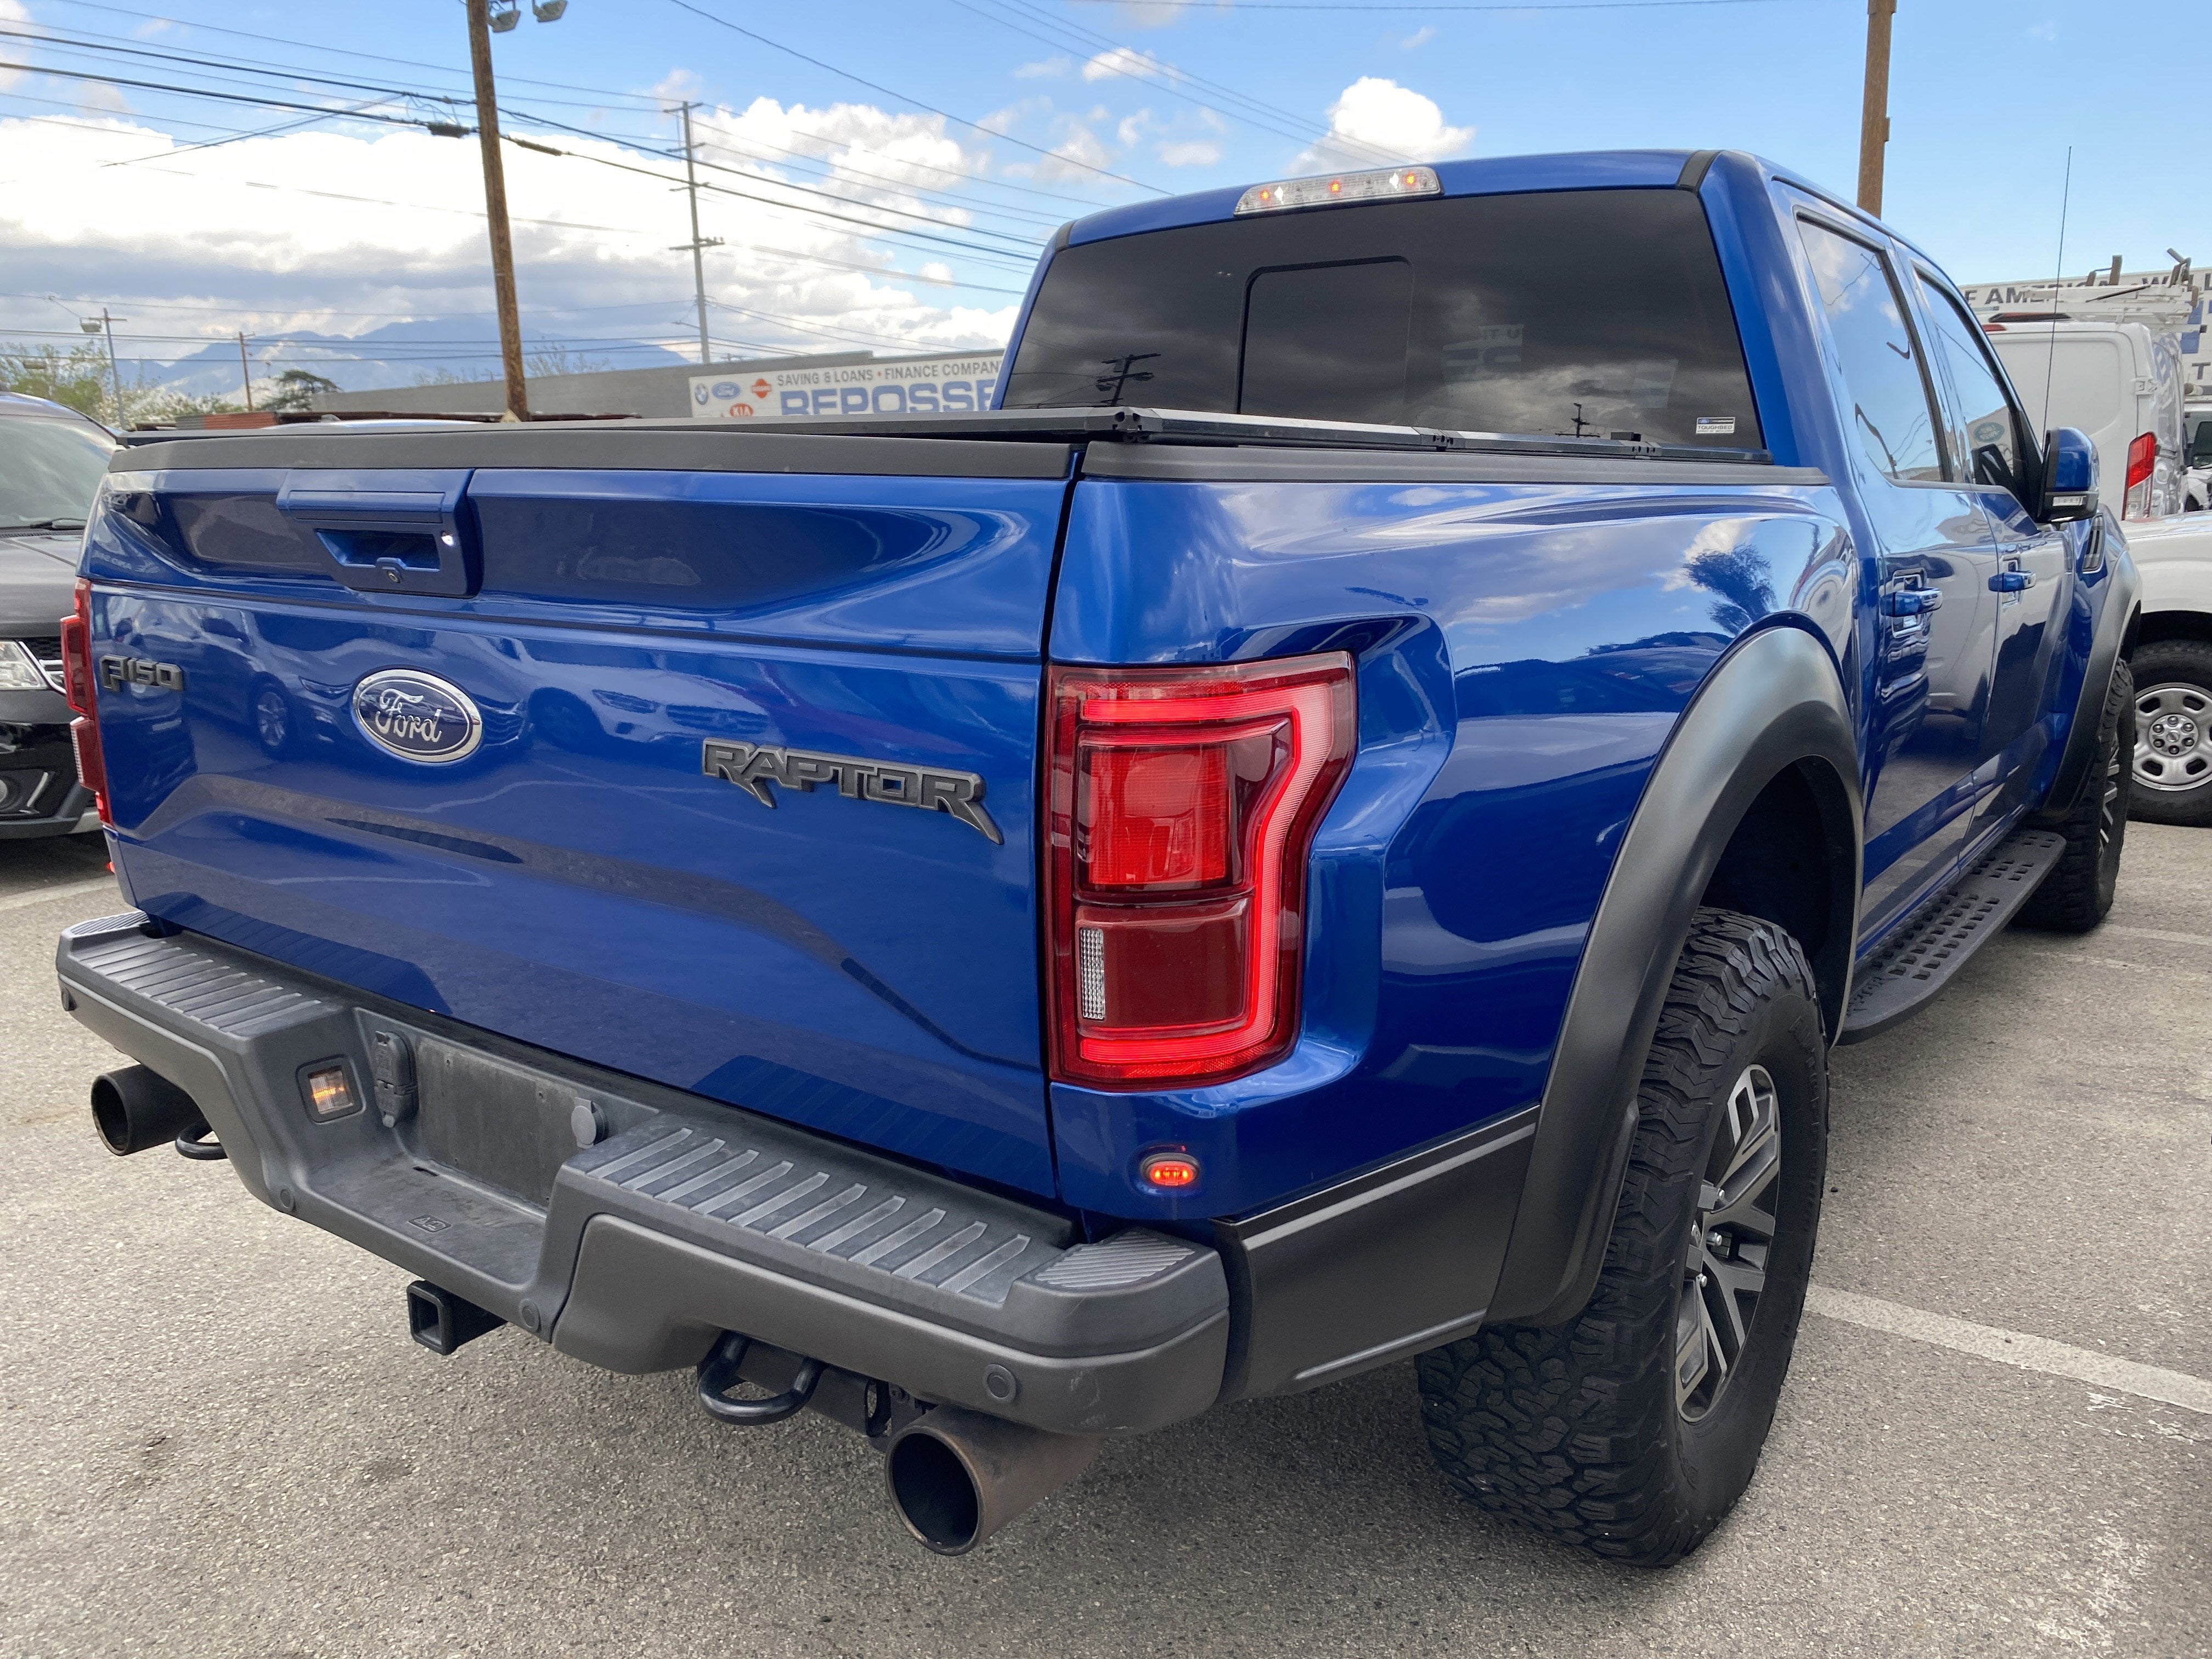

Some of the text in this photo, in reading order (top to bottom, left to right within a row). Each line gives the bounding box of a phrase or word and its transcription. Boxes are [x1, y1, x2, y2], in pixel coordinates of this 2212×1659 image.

[777, 373, 819, 386] SAVING
[834, 369, 873, 383] LOANS
[884, 364, 939, 380] FINANCE
[943, 360, 1002, 376] COMPAN
[375, 687, 443, 743] Ford
[702, 737, 1005, 845] RAPTOR
